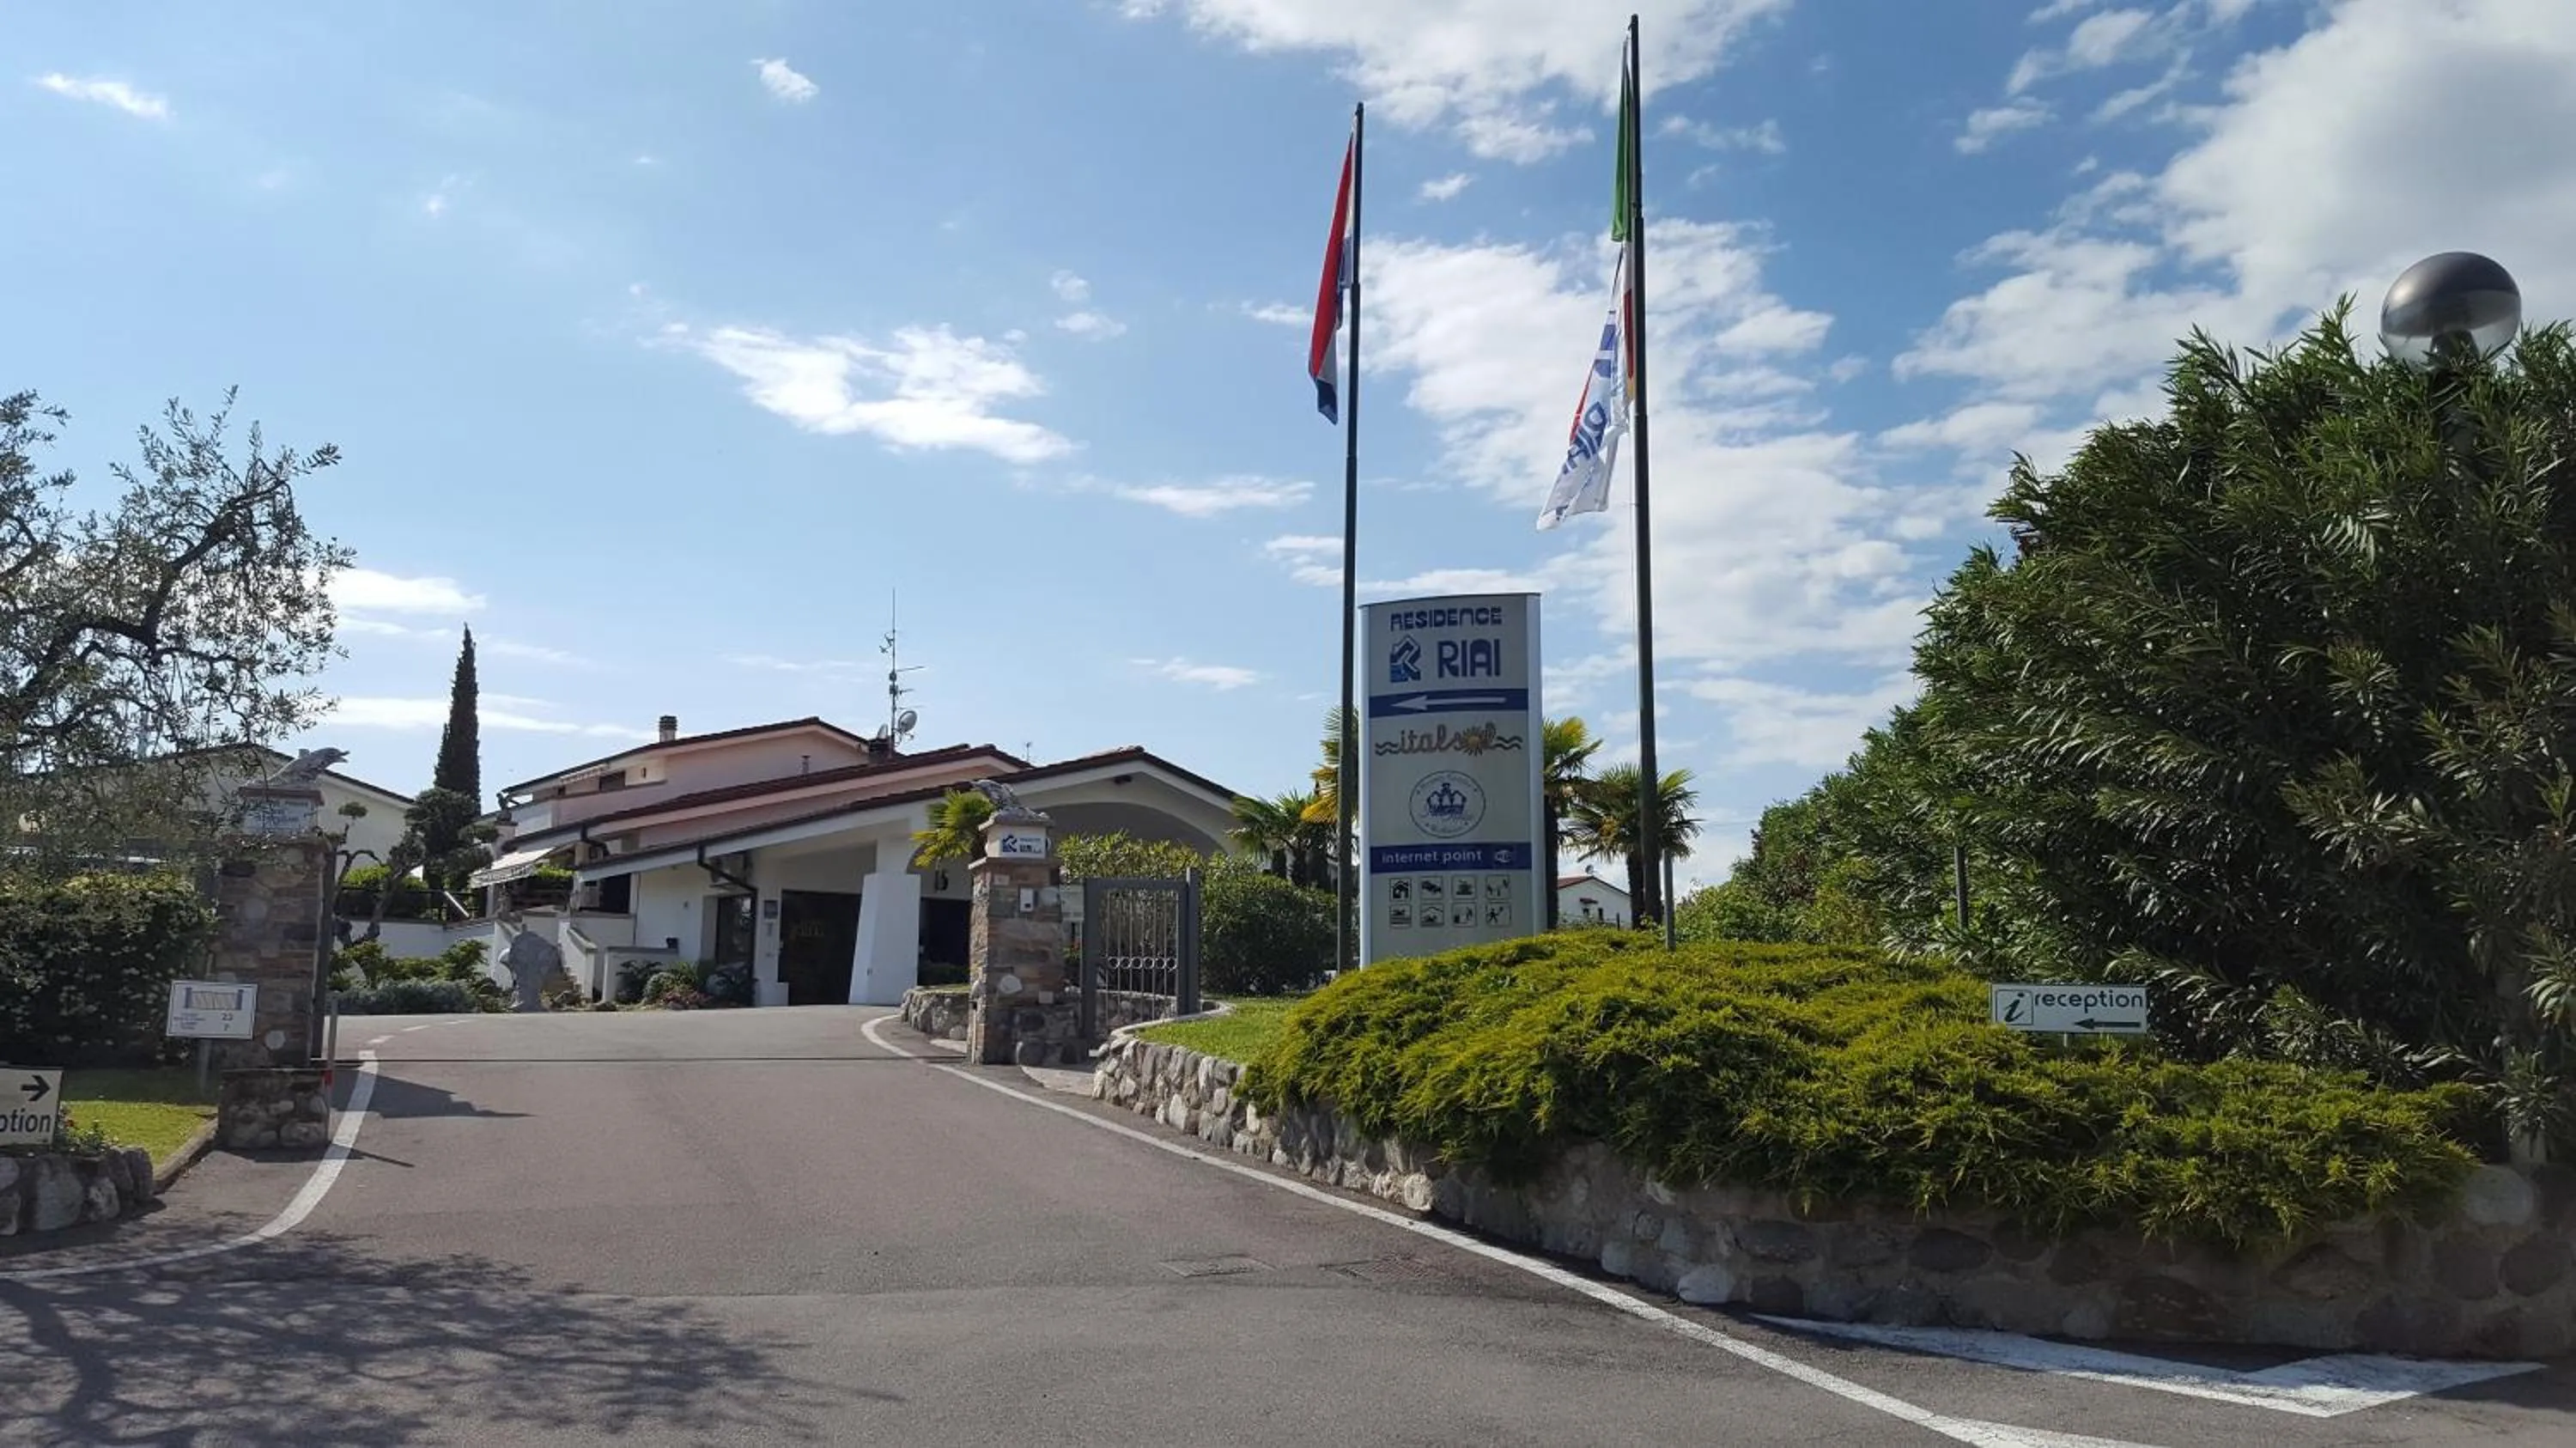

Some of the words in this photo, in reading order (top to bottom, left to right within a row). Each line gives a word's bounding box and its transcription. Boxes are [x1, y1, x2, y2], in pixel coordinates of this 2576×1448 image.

[1390, 606, 1502, 631] RESIDENCE
[1438, 638, 1500, 678] RIAI
[1382, 850, 1439, 864] internet
[1443, 849, 1483, 865] point
[2034, 989, 2143, 1013] reception
